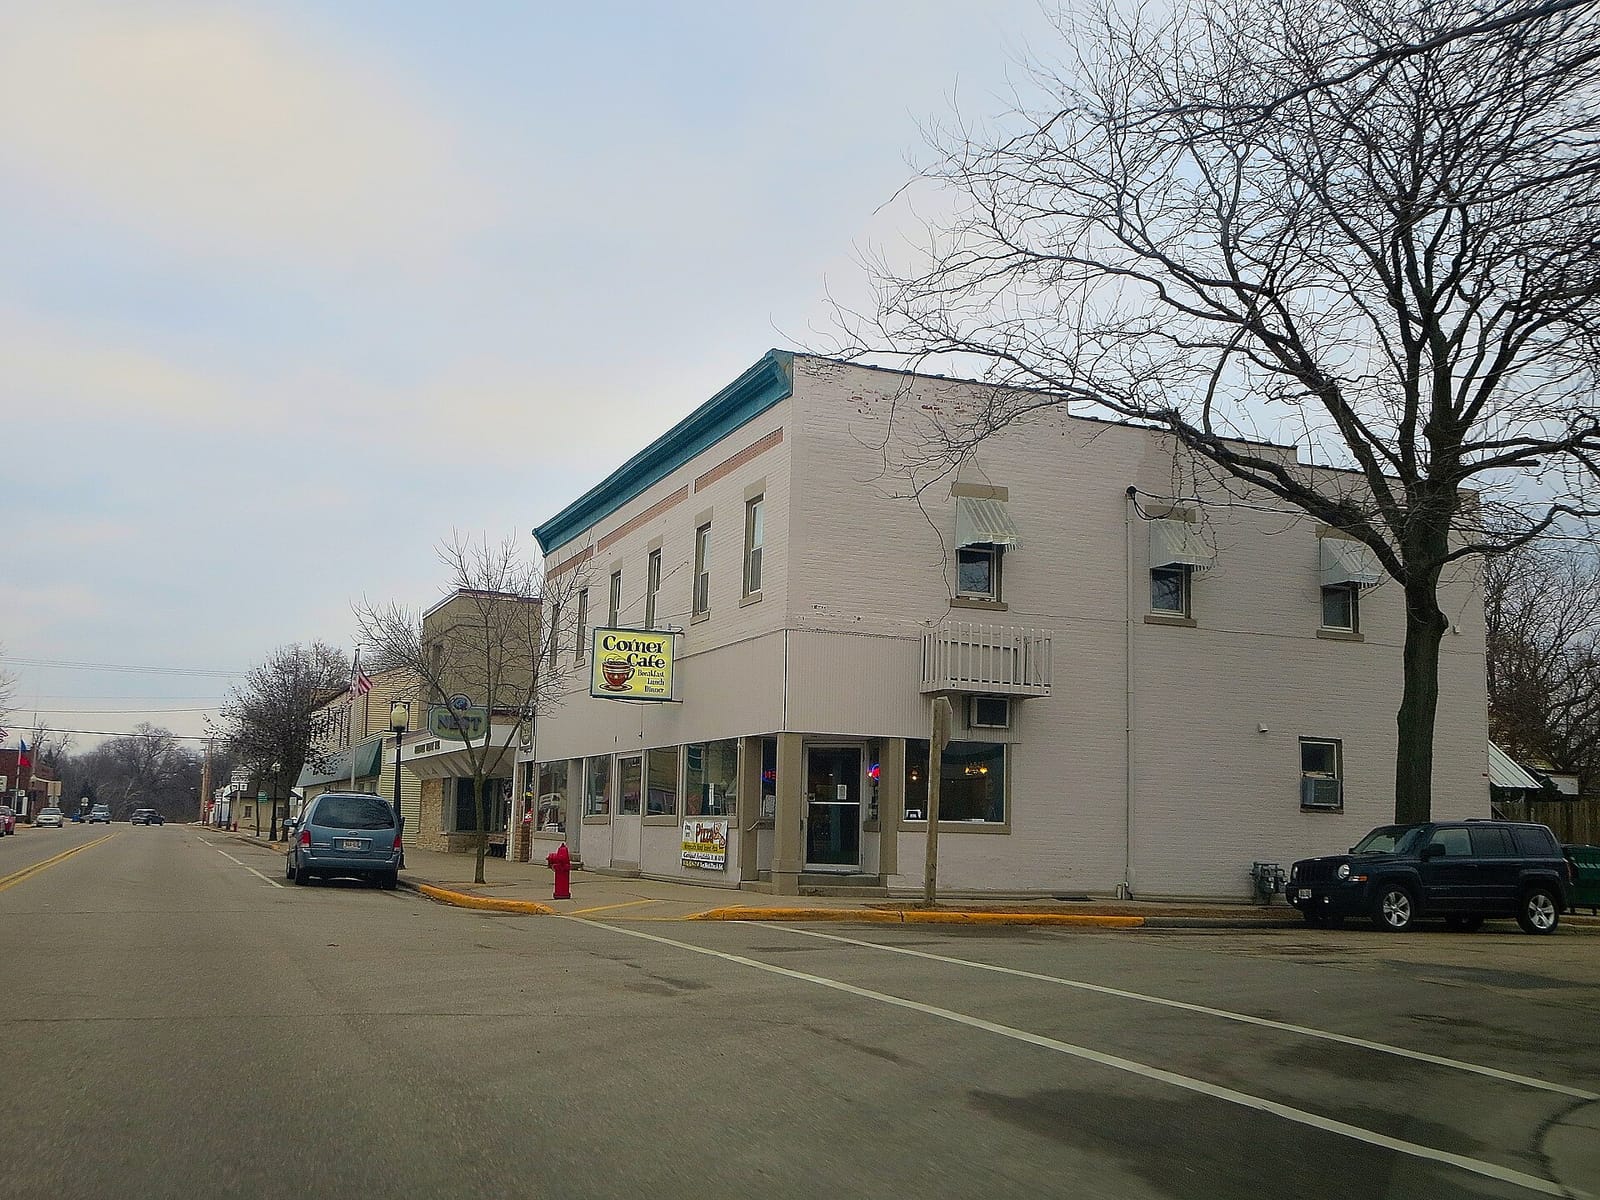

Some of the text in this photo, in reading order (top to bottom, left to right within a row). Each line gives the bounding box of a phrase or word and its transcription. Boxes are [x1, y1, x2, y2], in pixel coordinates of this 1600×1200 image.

[602, 635, 666, 653] Corner
[626, 653, 666, 668] Cafe
[637, 669, 665, 678] Breakfast
[647, 678, 665, 686] Lunch
[644, 685, 665, 693] Dinner
[695, 822, 714, 844] Pizza
